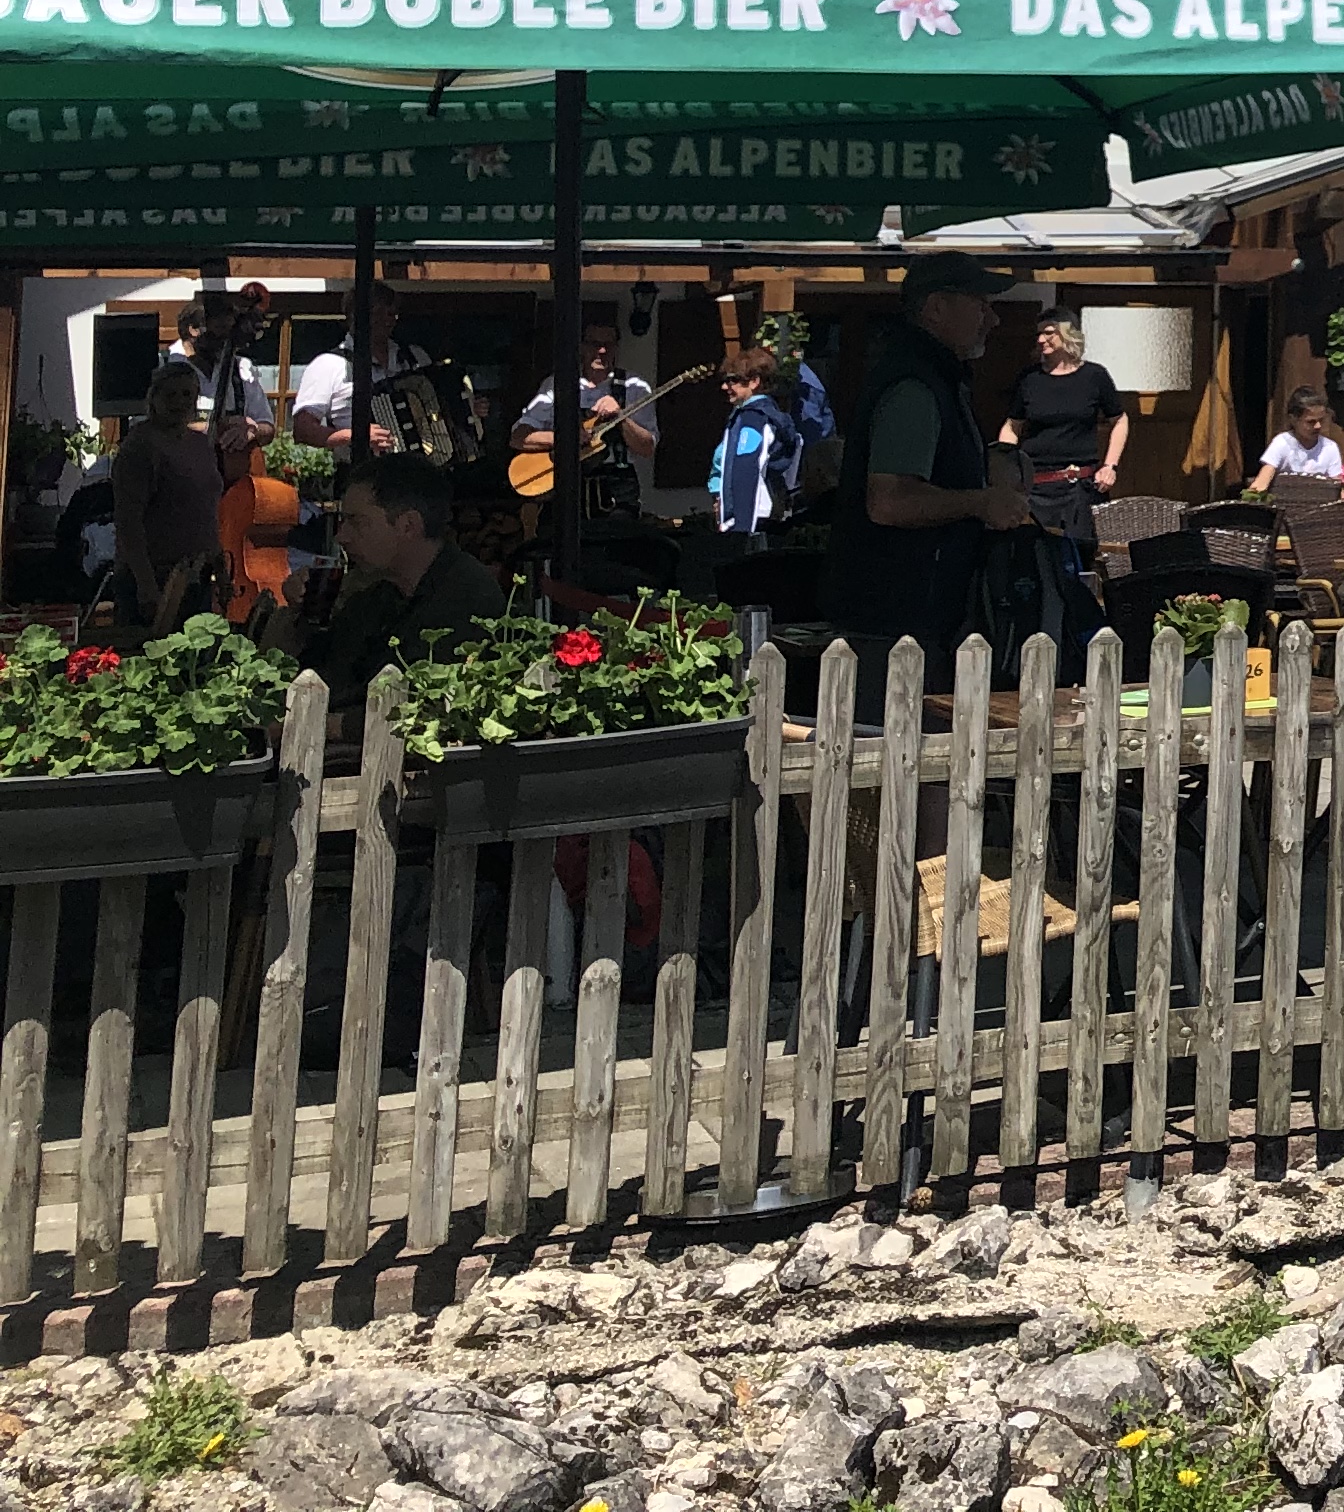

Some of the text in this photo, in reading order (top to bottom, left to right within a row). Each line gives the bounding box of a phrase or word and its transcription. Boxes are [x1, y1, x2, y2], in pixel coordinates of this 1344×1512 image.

[551, 137, 654, 177] AS
[668, 136, 964, 180] ALPENBIER
[1245, 662, 1264, 679] 26
